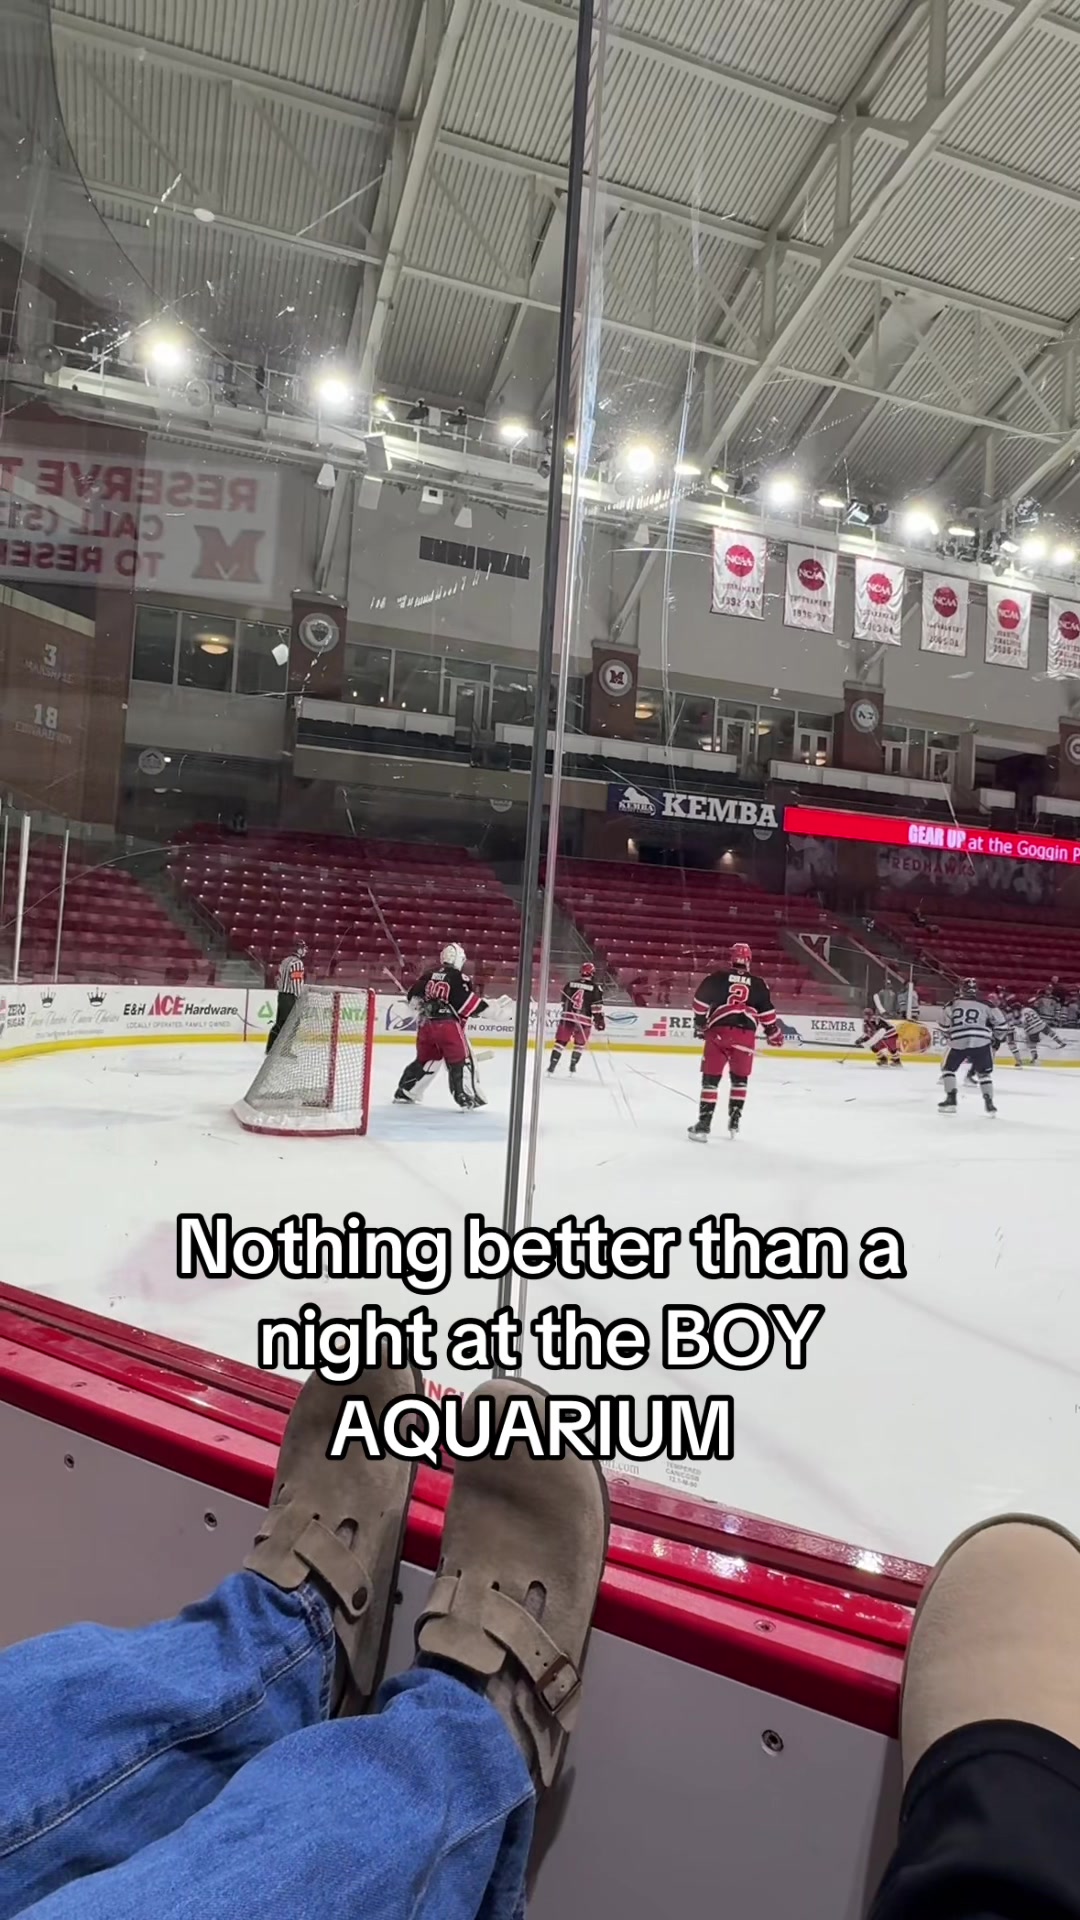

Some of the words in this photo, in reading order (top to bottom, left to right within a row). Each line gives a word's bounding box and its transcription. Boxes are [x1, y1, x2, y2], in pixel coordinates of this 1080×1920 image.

[43, 643, 57, 667] 3
[33, 703, 58, 730] 18
[661, 792, 779, 829] KEMBA
[908, 824, 944, 845] GEAR
[946, 828, 966, 848] UP
[968, 836, 984, 851] at
[988, 838, 1013, 854] the
[1016, 840, 1069, 861] Goggin
[892, 857, 975, 877] REDHAWKS
[123, 1003, 146, 1016] E&H
[147, 993, 186, 1016] ACE
[184, 1003, 238, 1016] Hardware
[571, 989, 585, 1010] 4
[727, 983, 750, 1005] 2
[8, 1003, 26, 1017] ZERO
[951, 1008, 979, 1025] 28
[811, 1019, 856, 1033] KEMBA
